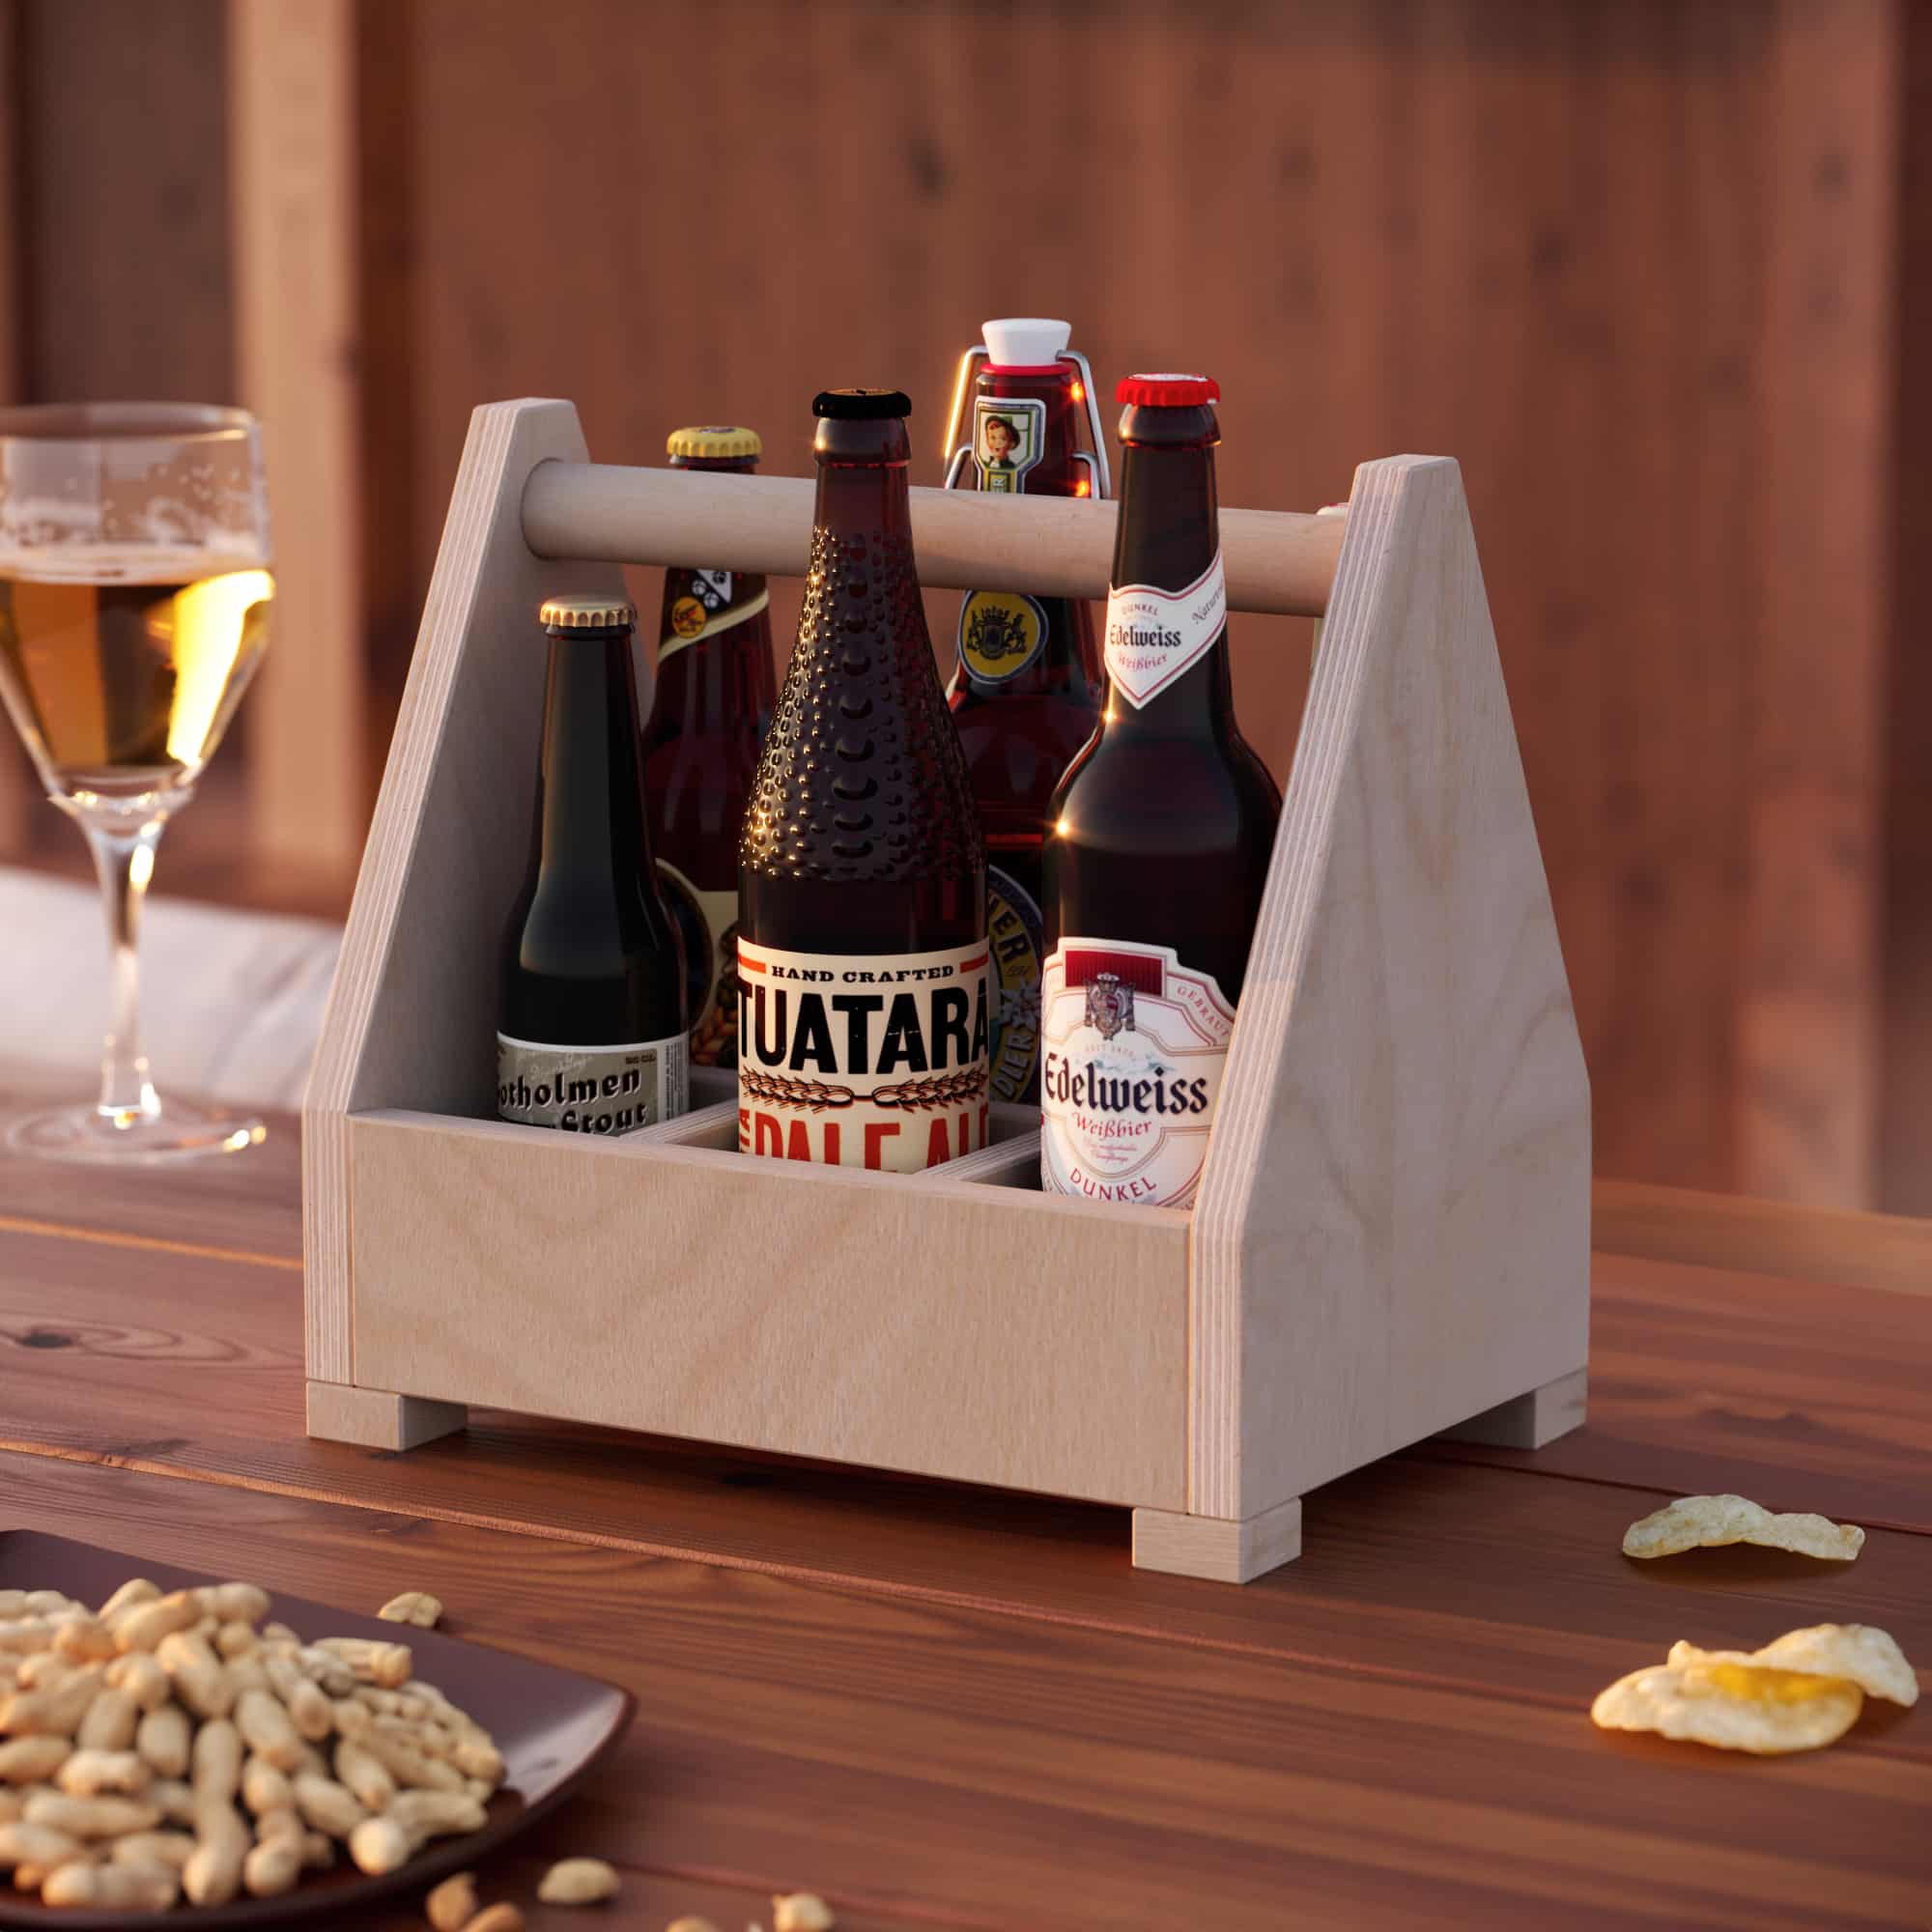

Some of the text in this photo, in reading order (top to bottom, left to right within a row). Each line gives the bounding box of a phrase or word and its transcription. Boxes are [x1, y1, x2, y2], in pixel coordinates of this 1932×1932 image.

[1110, 623, 1181, 648] Edelweiss
[772, 965, 954, 983] HAND CRAFTED
[738, 977, 988, 1075] TUATARA
[497, 1067, 641, 1112] otholmen
[1045, 1052, 1208, 1114] Edelweiss
[1071, 1111, 1152, 1140] Weißbier
[1069, 1167, 1157, 1202] DUNKEL
